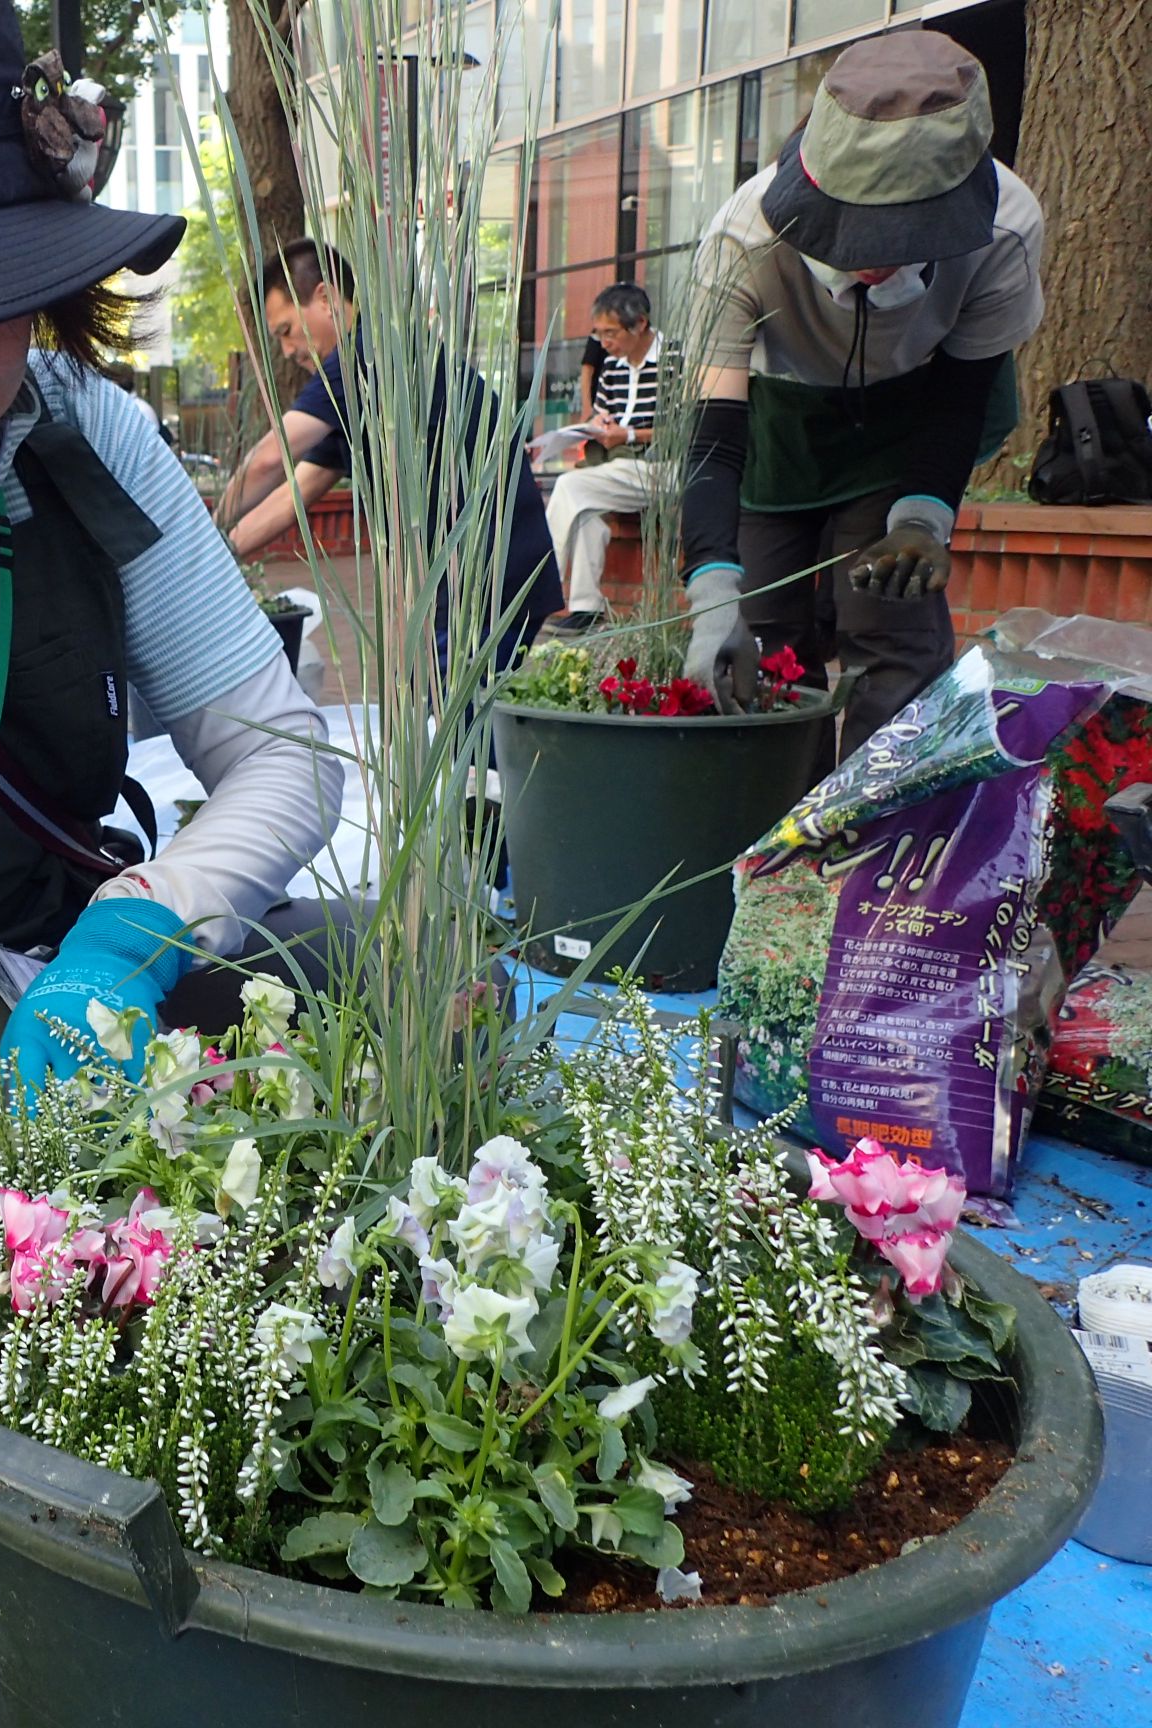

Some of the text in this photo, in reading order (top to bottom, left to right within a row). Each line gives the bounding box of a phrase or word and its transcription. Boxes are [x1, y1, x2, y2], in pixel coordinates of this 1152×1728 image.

[857, 901, 968, 927] オープンガーデン
[884, 919, 935, 937] って何?
[836, 1116, 933, 1149] 長期肥効型
